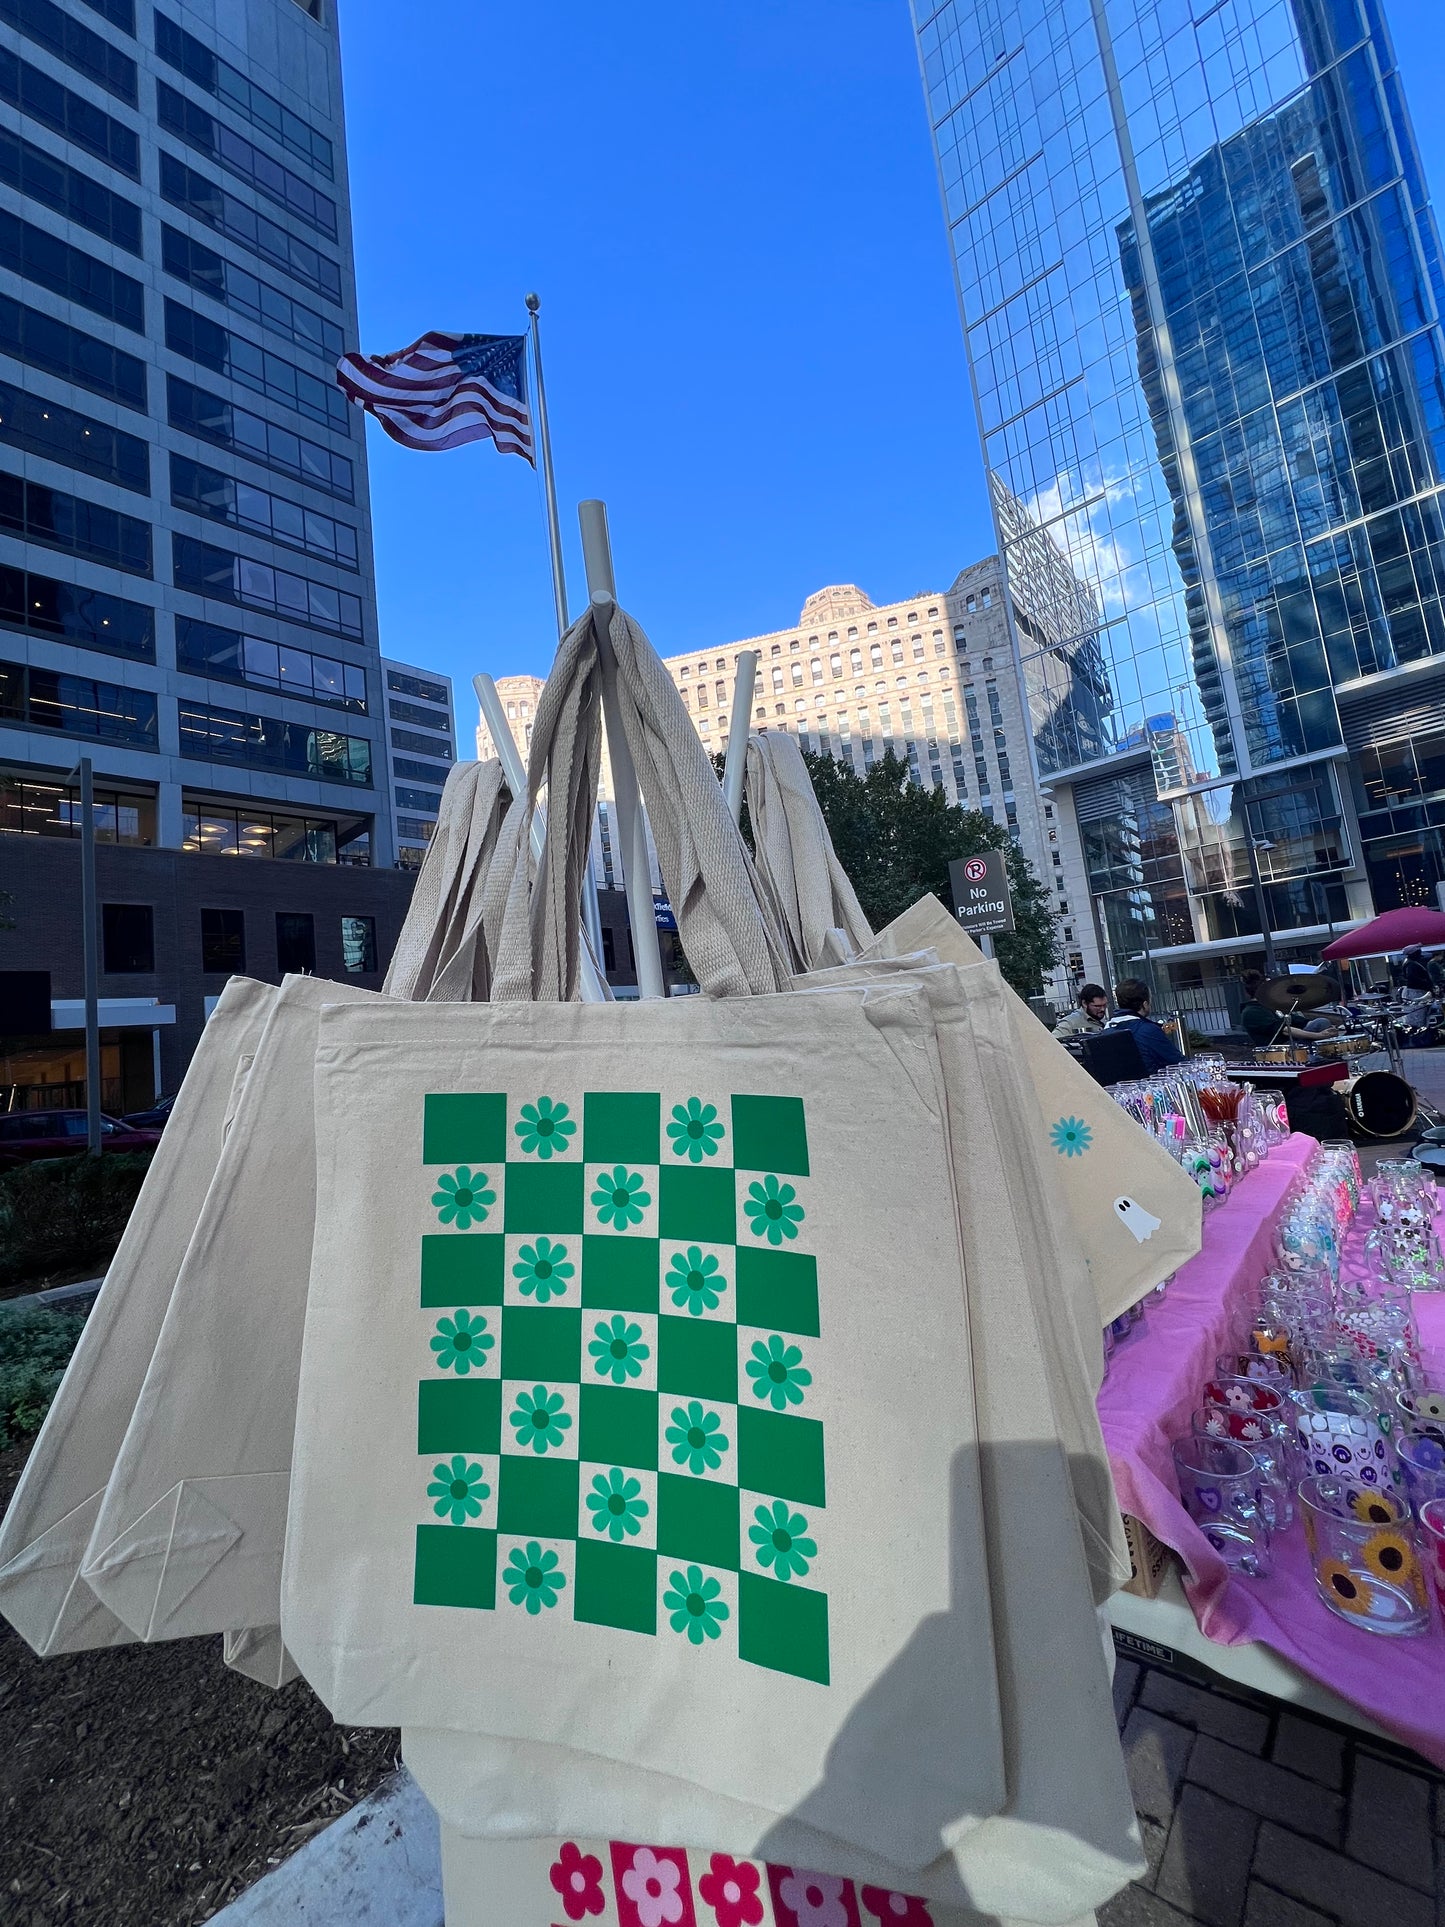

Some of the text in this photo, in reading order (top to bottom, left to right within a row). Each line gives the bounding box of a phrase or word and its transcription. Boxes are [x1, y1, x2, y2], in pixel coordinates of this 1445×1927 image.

[970, 888, 987, 899] No
[958, 900, 1005, 917] Parking
[1113, 1631, 1166, 1658] IFETIME
